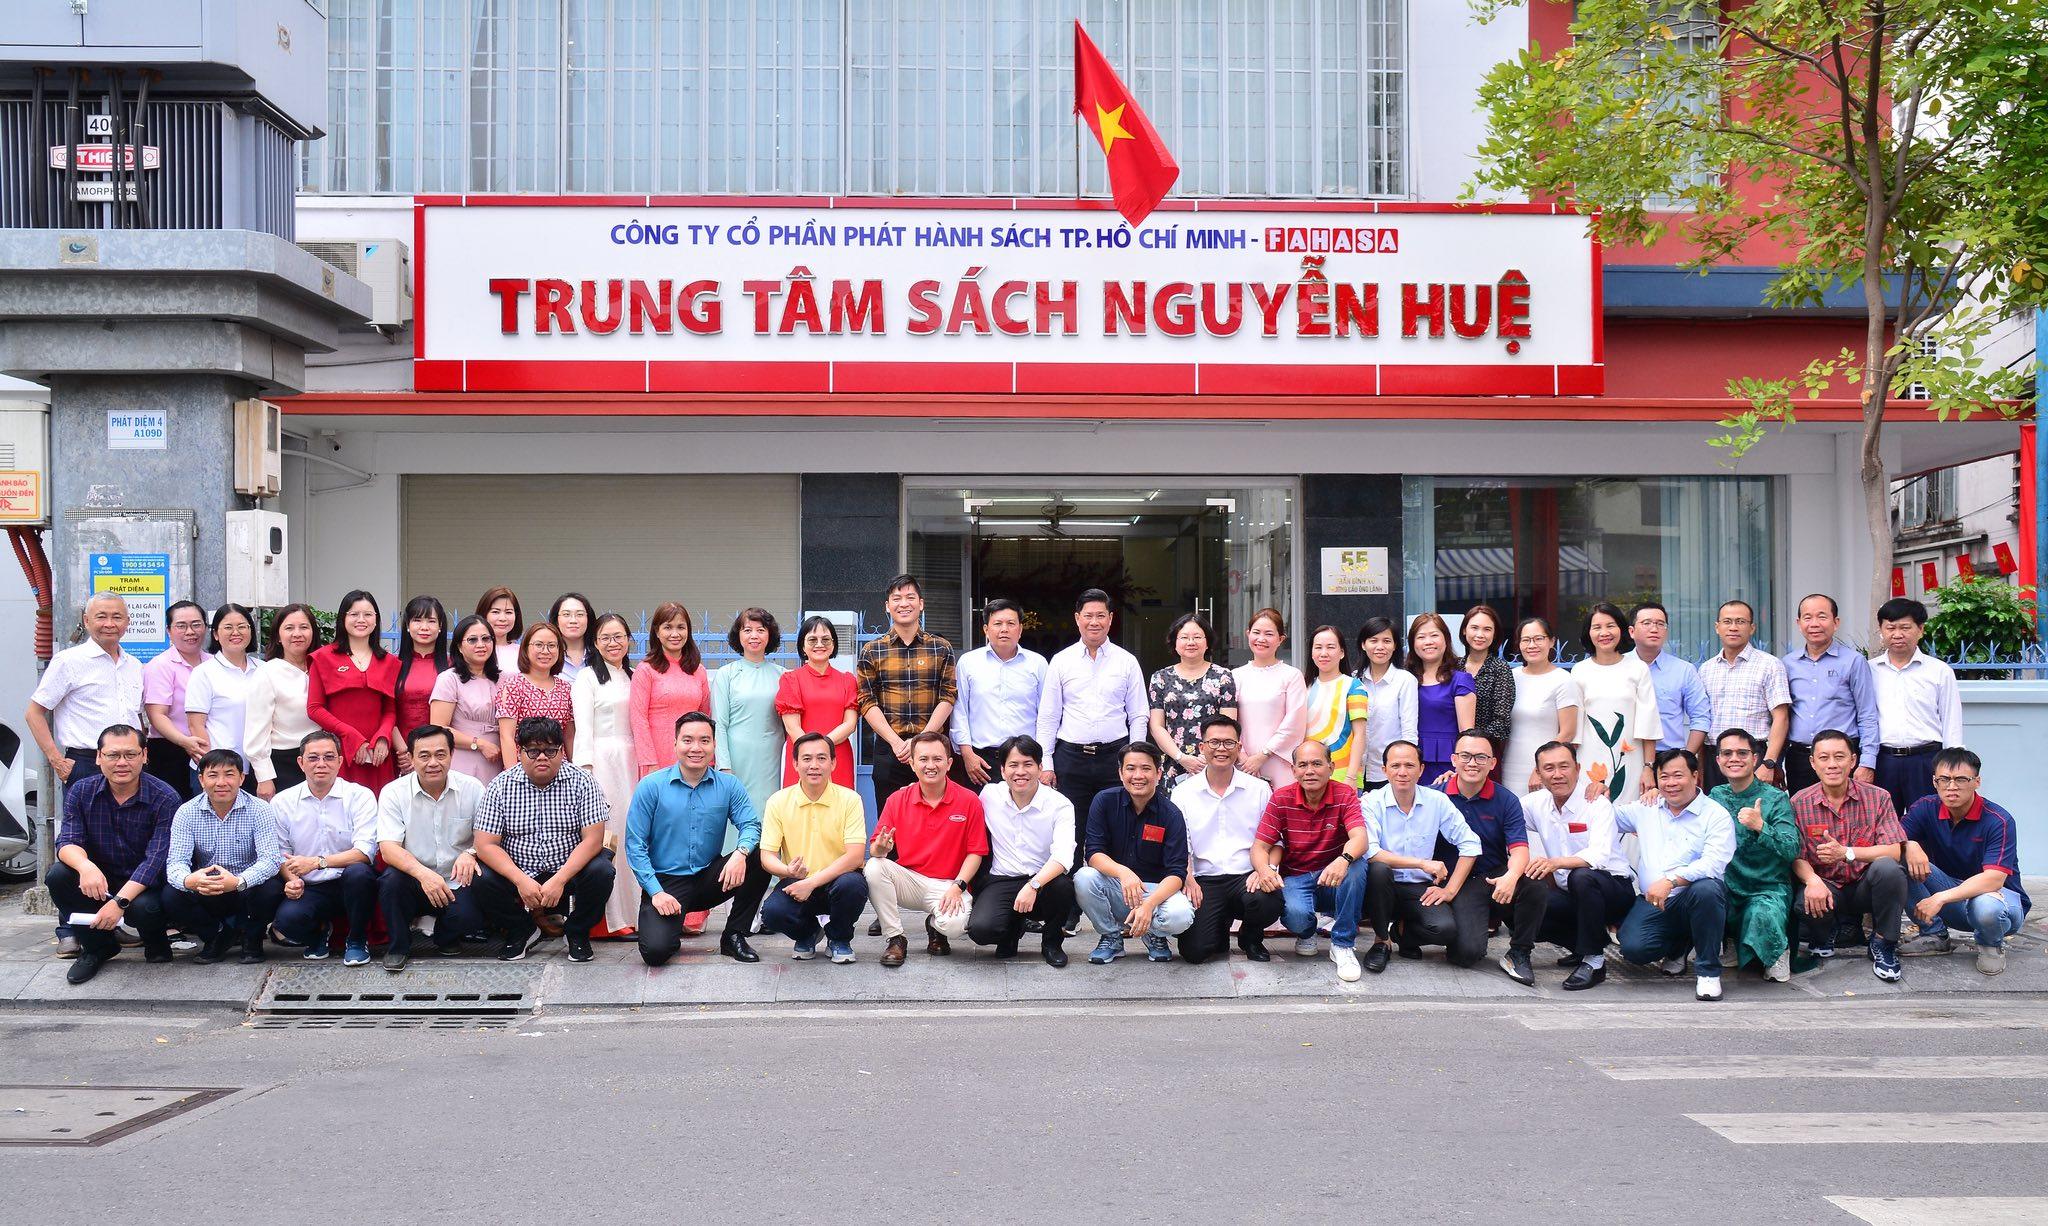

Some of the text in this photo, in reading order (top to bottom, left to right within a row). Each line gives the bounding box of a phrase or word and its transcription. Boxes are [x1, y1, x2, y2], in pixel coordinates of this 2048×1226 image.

[89, 118, 113, 132] 40
[610, 218, 680, 246] CÔNG
[687, 223, 721, 246] TY
[726, 215, 761, 246] CỔ
[768, 217, 837, 247] PHẦN
[843, 221, 907, 247] PHÁT
[914, 222, 984, 248] HÀNH
[990, 222, 1052, 249] SÁCH
[1138, 223, 1177, 250] CHÍ
[1266, 227, 1399, 253] FAHASA
[488, 254, 1533, 356] TRUNG TÂM SÁCH NGUYỄN HUỆ
[111, 414, 163, 429] PHÁT DIỆM 4
[133, 429, 163, 437] A109D
[1341, 551, 1368, 572] 55
